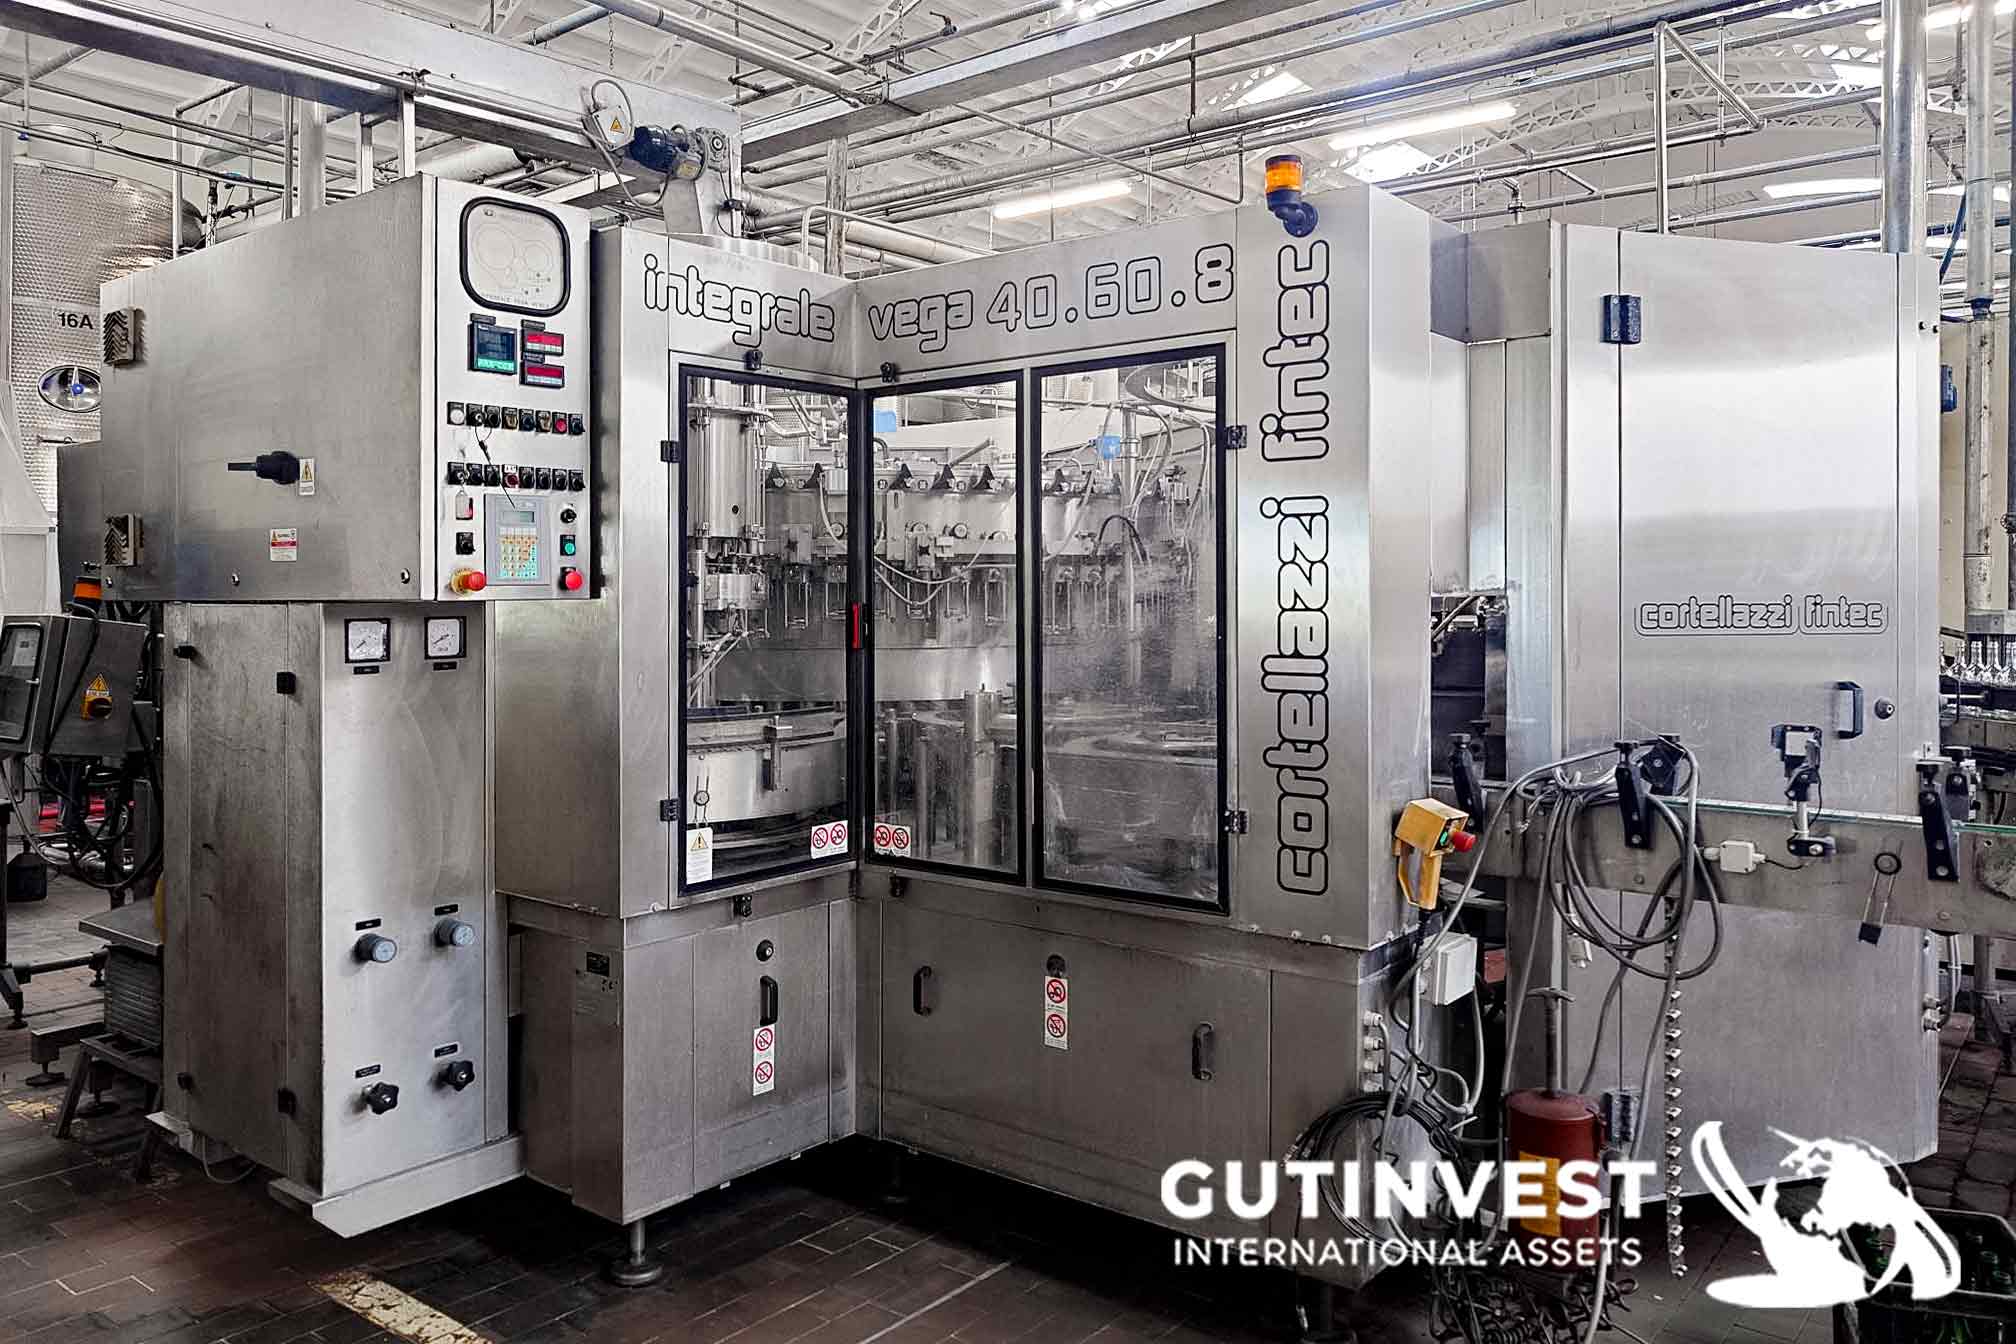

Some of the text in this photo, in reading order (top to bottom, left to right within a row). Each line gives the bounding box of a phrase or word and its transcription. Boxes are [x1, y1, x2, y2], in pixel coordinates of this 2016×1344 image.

[58, 312, 94, 330] 16A
[643, 253, 836, 349] integrale
[868, 243, 1235, 354] vega 40.60.8
[1259, 240, 1329, 896] cortellazzi fintec
[1640, 594, 1883, 629] cortellazzi fintec
